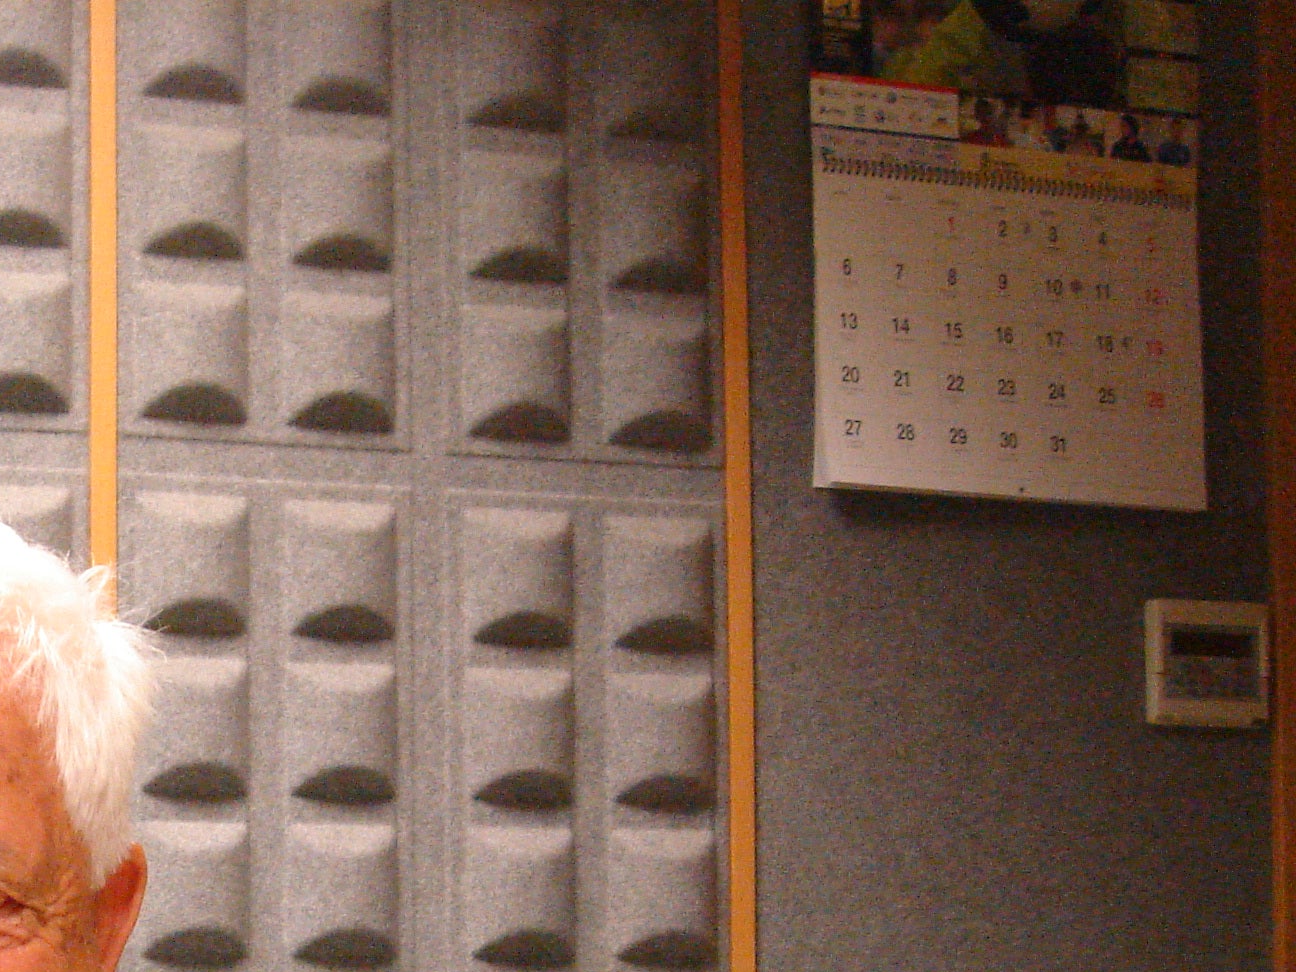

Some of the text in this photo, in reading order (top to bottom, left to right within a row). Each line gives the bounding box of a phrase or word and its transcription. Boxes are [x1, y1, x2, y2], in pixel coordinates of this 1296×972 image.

[998, 219, 1008, 238] 2
[1048, 226, 1058, 243] 3
[1099, 230, 1108, 246] 4
[843, 258, 852, 275] 6
[896, 263, 905, 281] 7
[947, 268, 957, 285] 8
[998, 274, 1008, 291] 9
[1046, 277, 1064, 296] 10
[1096, 283, 1110, 300] 11
[840, 312, 858, 330] 13
[892, 317, 910, 335] 14
[945, 322, 962, 340] 15
[996, 327, 1014, 345] 16
[1046, 331, 1064, 349] 17
[842, 365, 860, 384] 20
[894, 370, 911, 388] 21
[946, 374, 964, 392] 22
[998, 379, 1016, 396] 23
[1048, 382, 1066, 401] 24
[1098, 387, 1116, 404] 25
[845, 419, 1067, 453] 27 28 29 30 31
